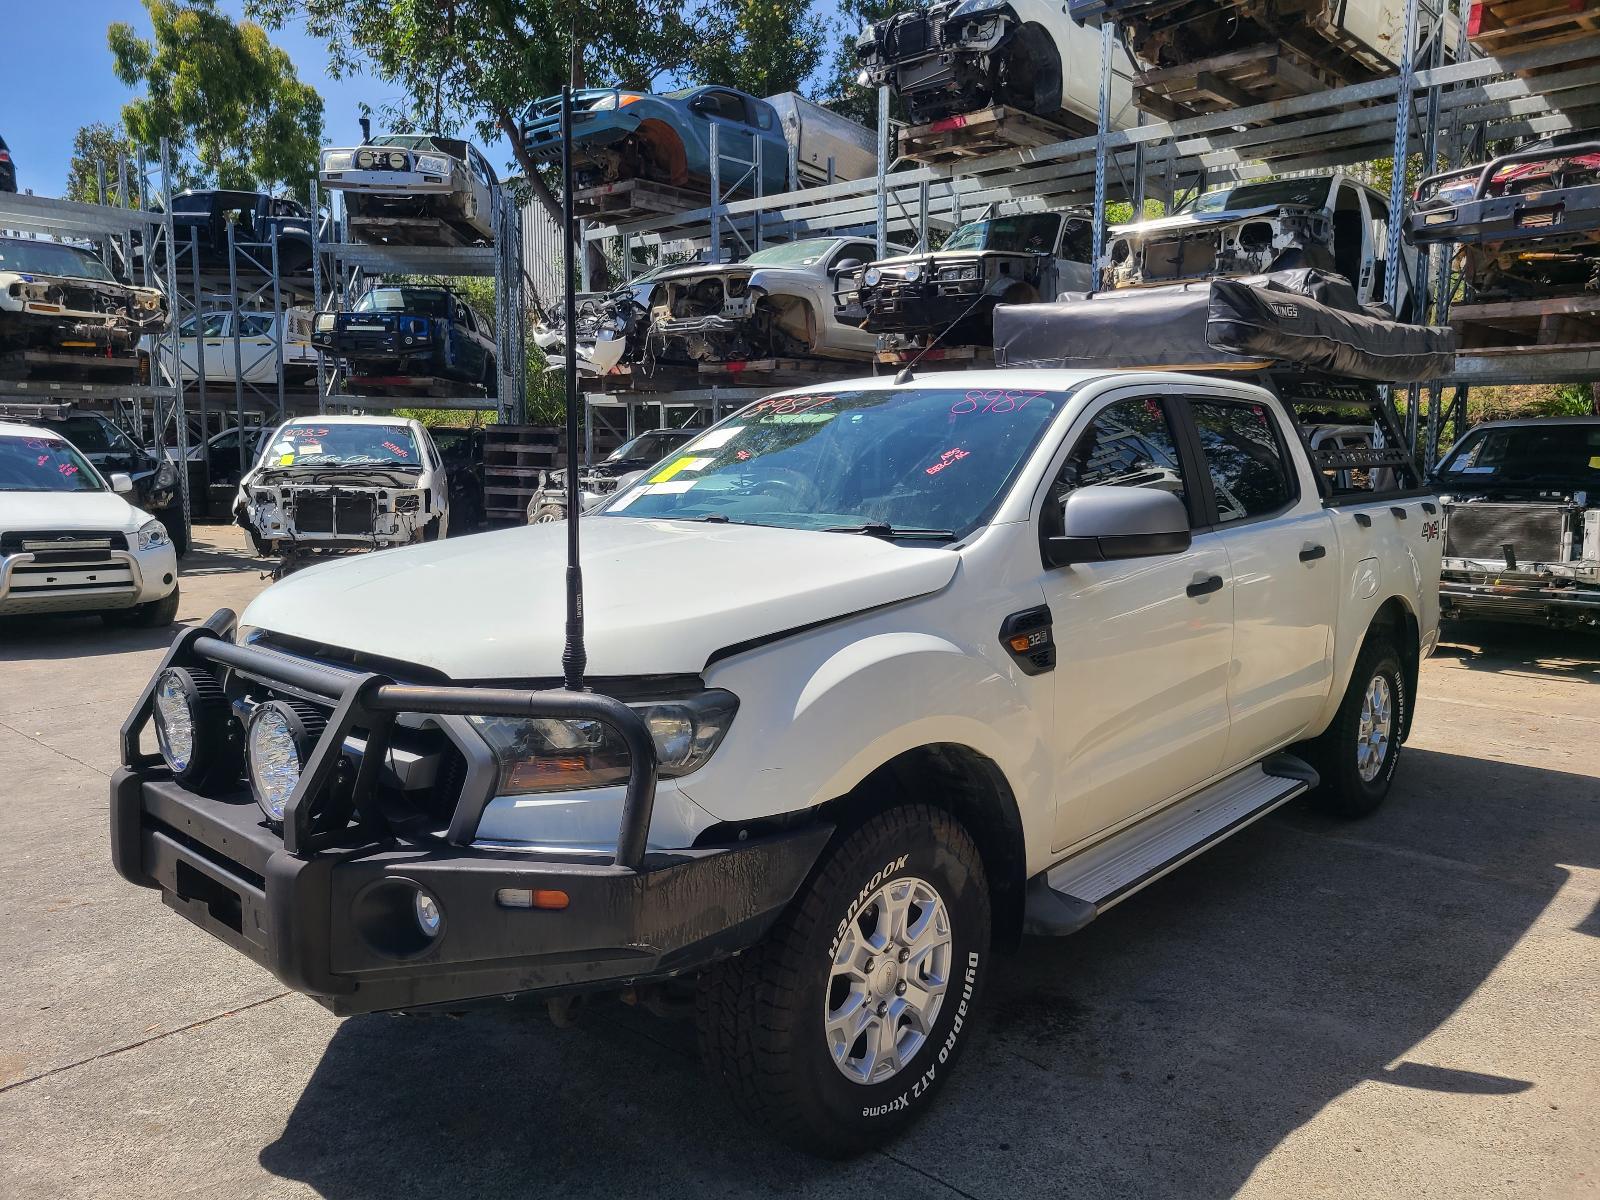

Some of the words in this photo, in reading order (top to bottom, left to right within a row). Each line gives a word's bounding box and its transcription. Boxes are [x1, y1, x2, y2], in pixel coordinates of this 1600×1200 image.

[741, 396, 836, 418] 8987
[952, 389, 1047, 414] 8987
[911, 1063, 937, 1099] AT2
[862, 1089, 909, 1118] Xtreme
